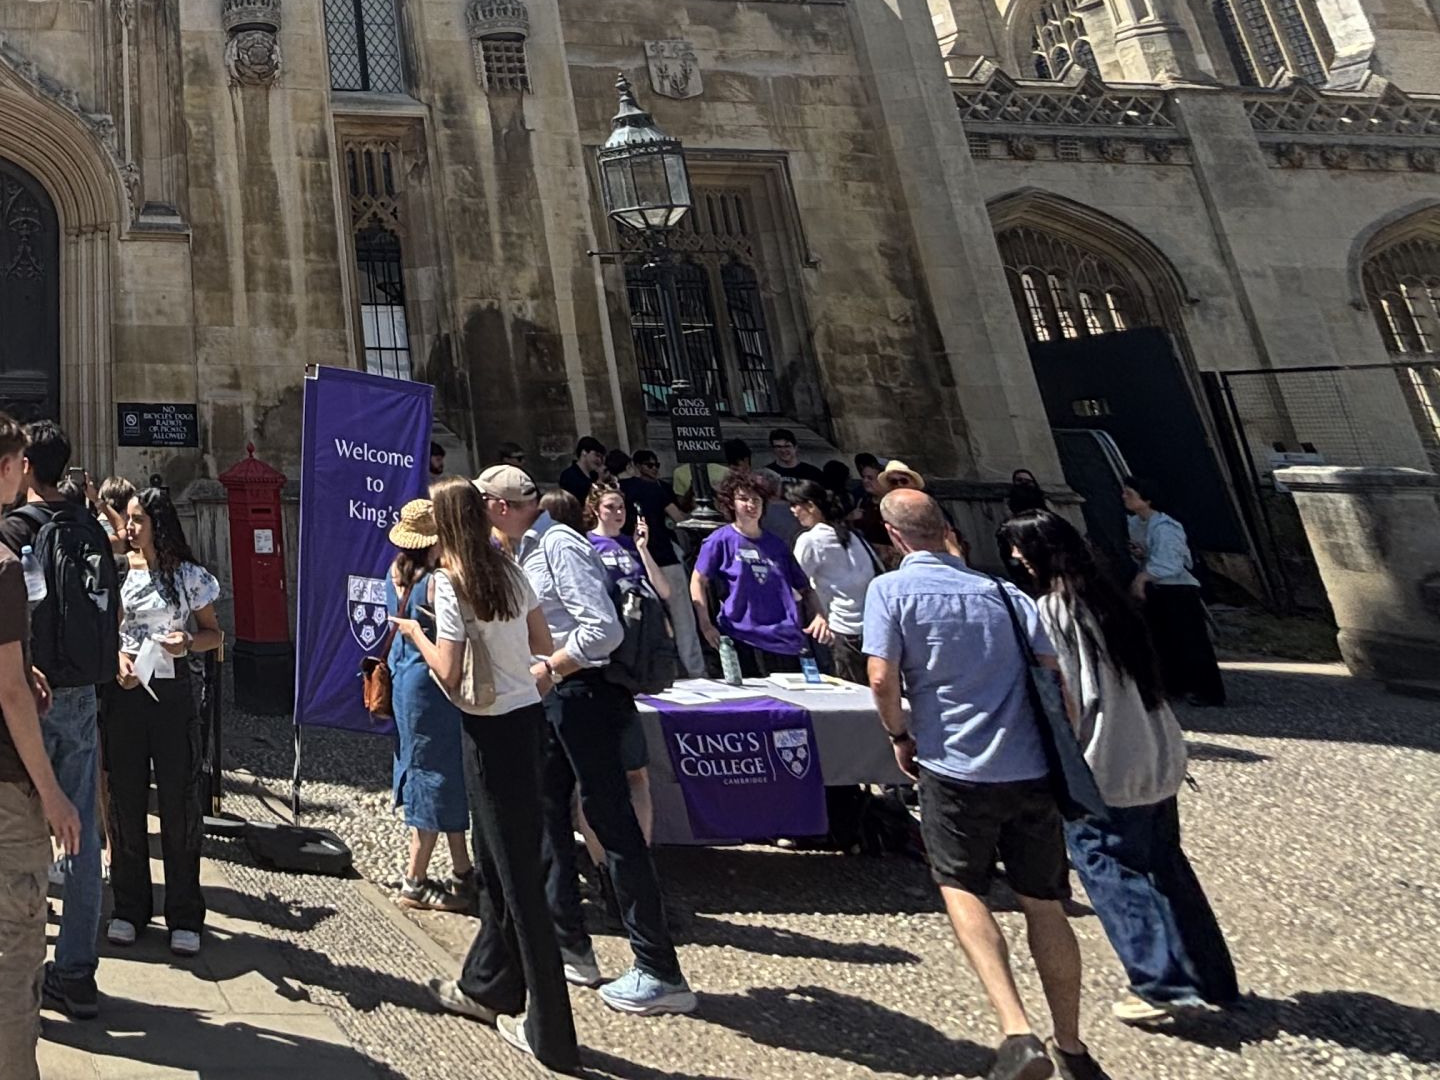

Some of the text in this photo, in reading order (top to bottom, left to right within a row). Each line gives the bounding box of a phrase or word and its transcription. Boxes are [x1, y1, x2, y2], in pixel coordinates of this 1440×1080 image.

[162, 405, 176, 413] NO
[672, 406, 712, 417] COLLEGE
[676, 426, 717, 437] PRIVATE
[676, 440, 721, 451] PARKING
[335, 438, 414, 469] Welcome
[366, 476, 384, 493] to
[349, 499, 400, 528] King's
[674, 732, 761, 757] KING'S
[680, 757, 767, 777] COLLEGE
[723, 777, 768, 785] CAMBRIDGE
